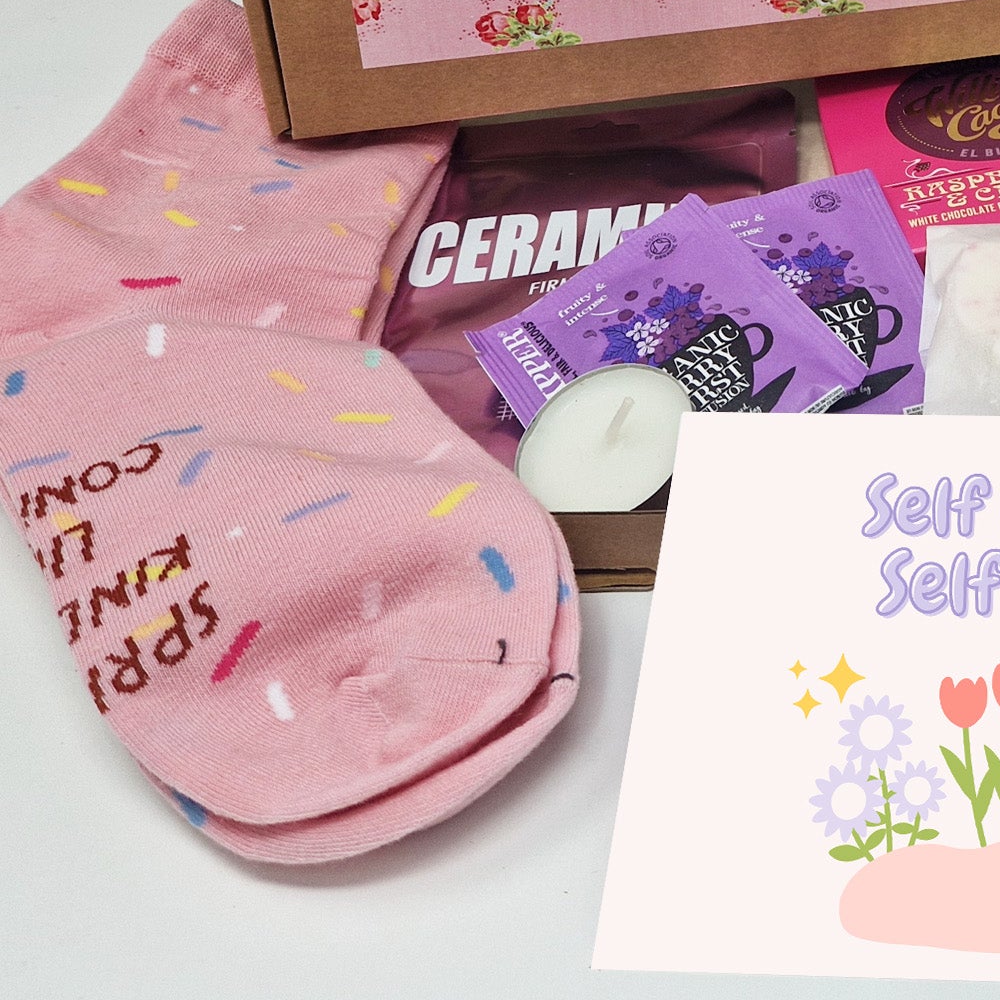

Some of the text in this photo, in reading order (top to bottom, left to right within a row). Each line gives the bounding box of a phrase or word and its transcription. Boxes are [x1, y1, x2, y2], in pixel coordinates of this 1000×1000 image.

[960, 148, 977, 158] EL
[908, 209, 939, 228] WHITE
[941, 204, 997, 222] CHOCOLATE
[946, 192, 967, 208] &
[408, 203, 678, 288] CERAM
[558, 282, 607, 318] fruity &
[565, 294, 608, 326] intense
[522, 321, 556, 357] DELICIOUS
[555, 358, 573, 376] FAIR
[861, 471, 994, 540] Self
